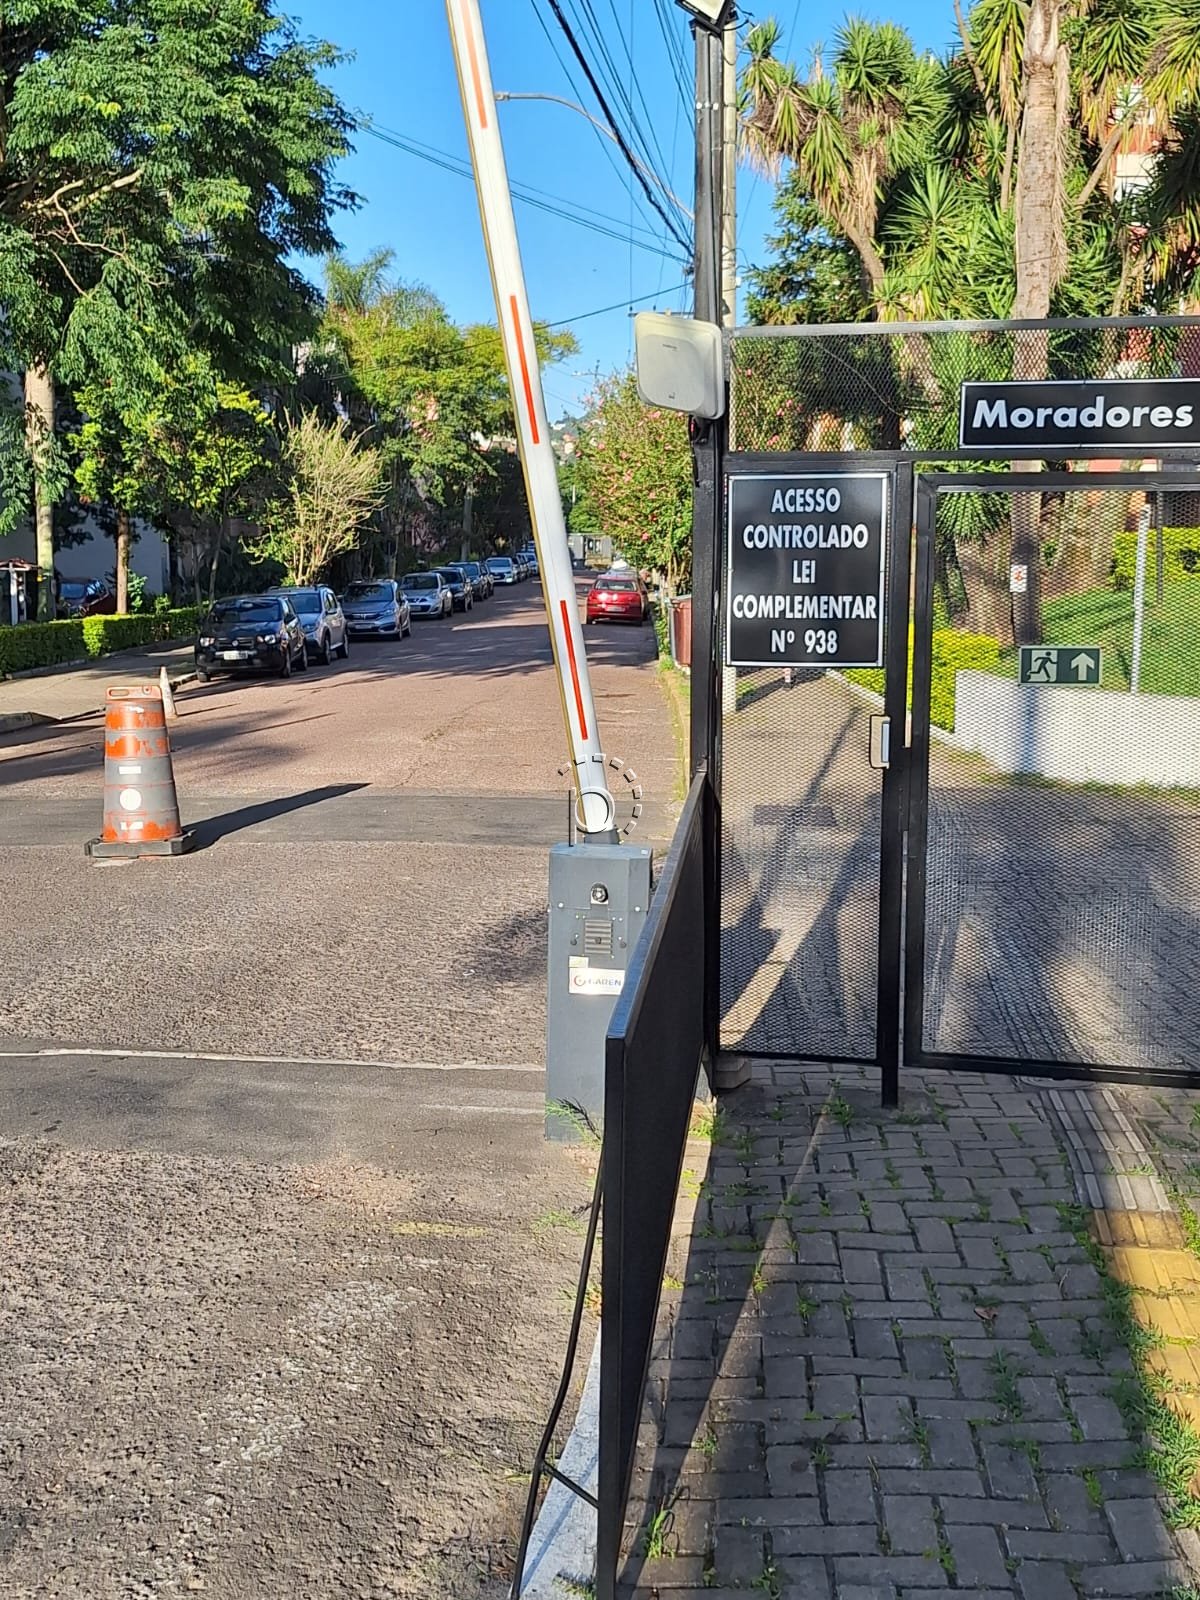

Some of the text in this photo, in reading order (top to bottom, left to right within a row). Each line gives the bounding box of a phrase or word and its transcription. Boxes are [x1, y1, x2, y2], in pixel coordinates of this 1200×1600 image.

[972, 396, 1193, 429] Moradores
[771, 487, 841, 513] ACESSO
[743, 523, 869, 549] CONTROLADO
[792, 559, 816, 584] LEI
[732, 594, 877, 619] COMPLEMENTAR
[804, 629, 838, 654] 938
